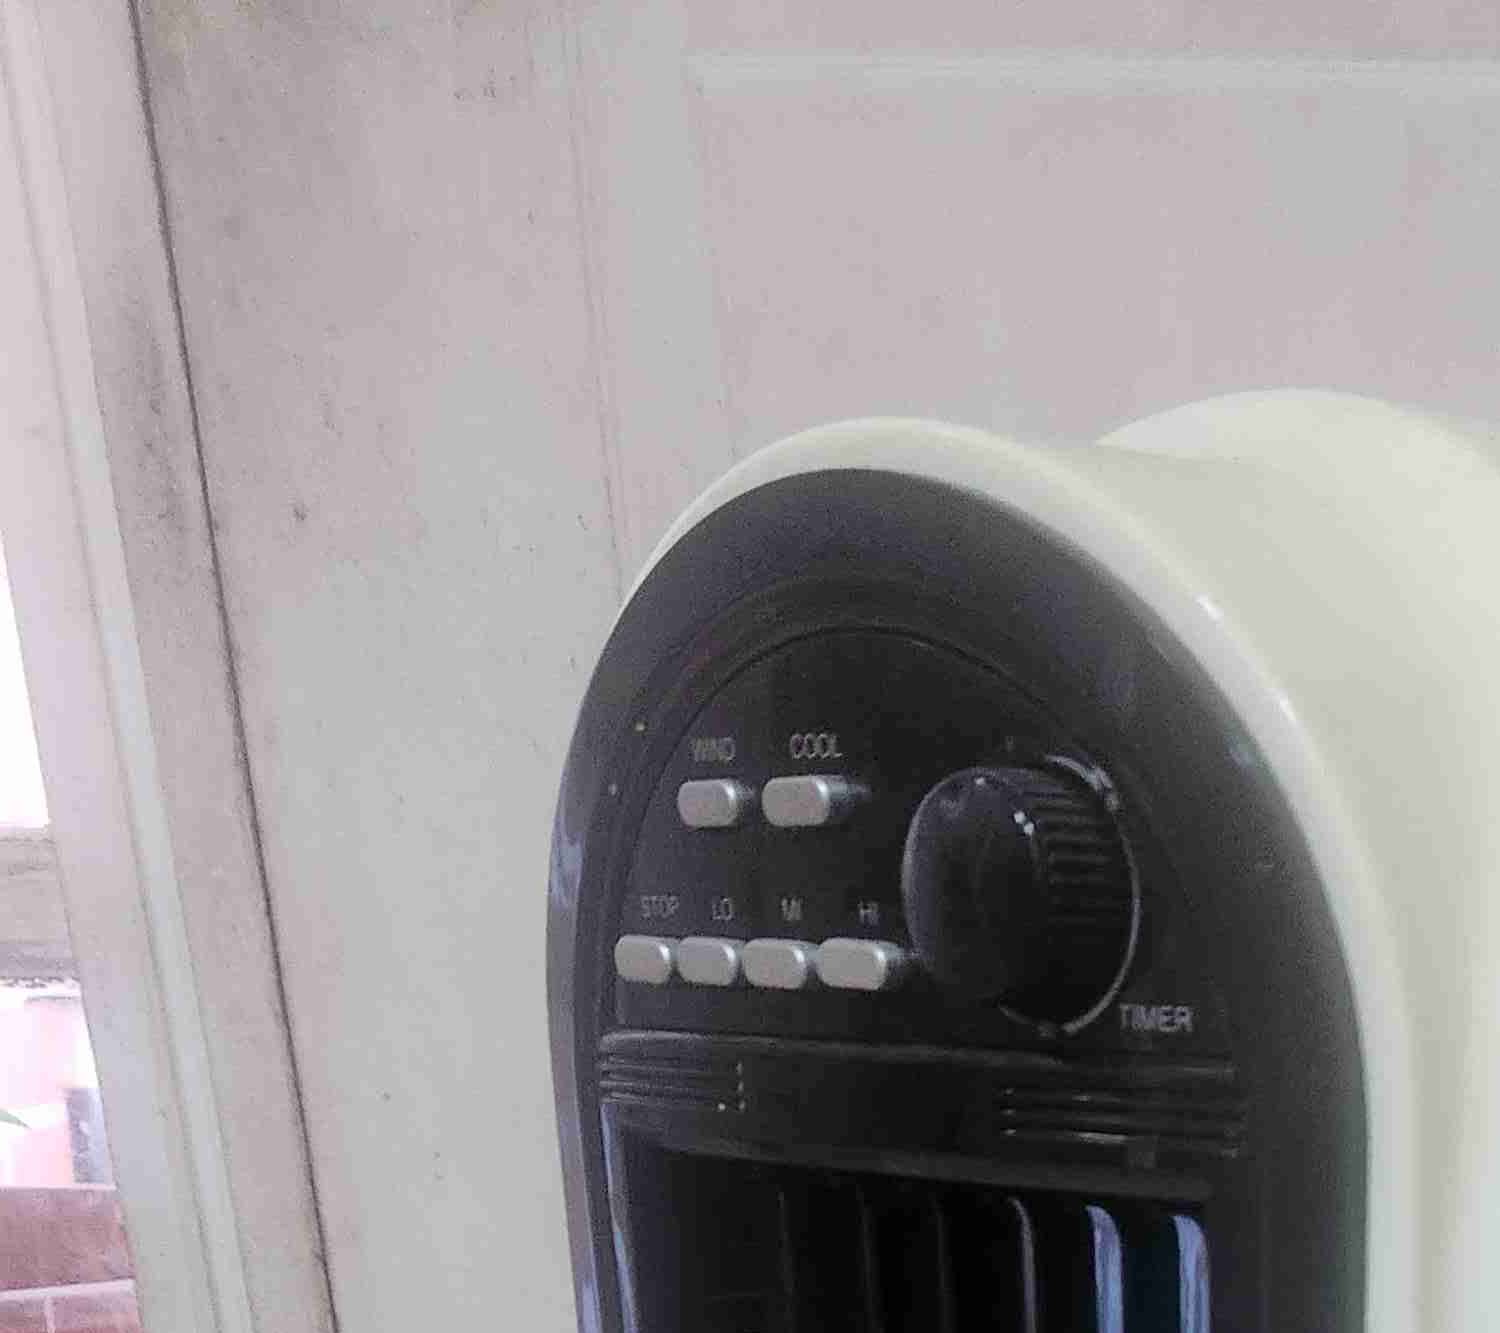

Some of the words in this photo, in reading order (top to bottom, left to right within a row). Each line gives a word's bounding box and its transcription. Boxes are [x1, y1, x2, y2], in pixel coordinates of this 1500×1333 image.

[690, 736, 736, 762] WIND
[791, 733, 842, 759] COOL
[640, 896, 680, 919] STOP
[858, 901, 879, 925] HI
[1119, 1002, 1195, 1032] TIMER
